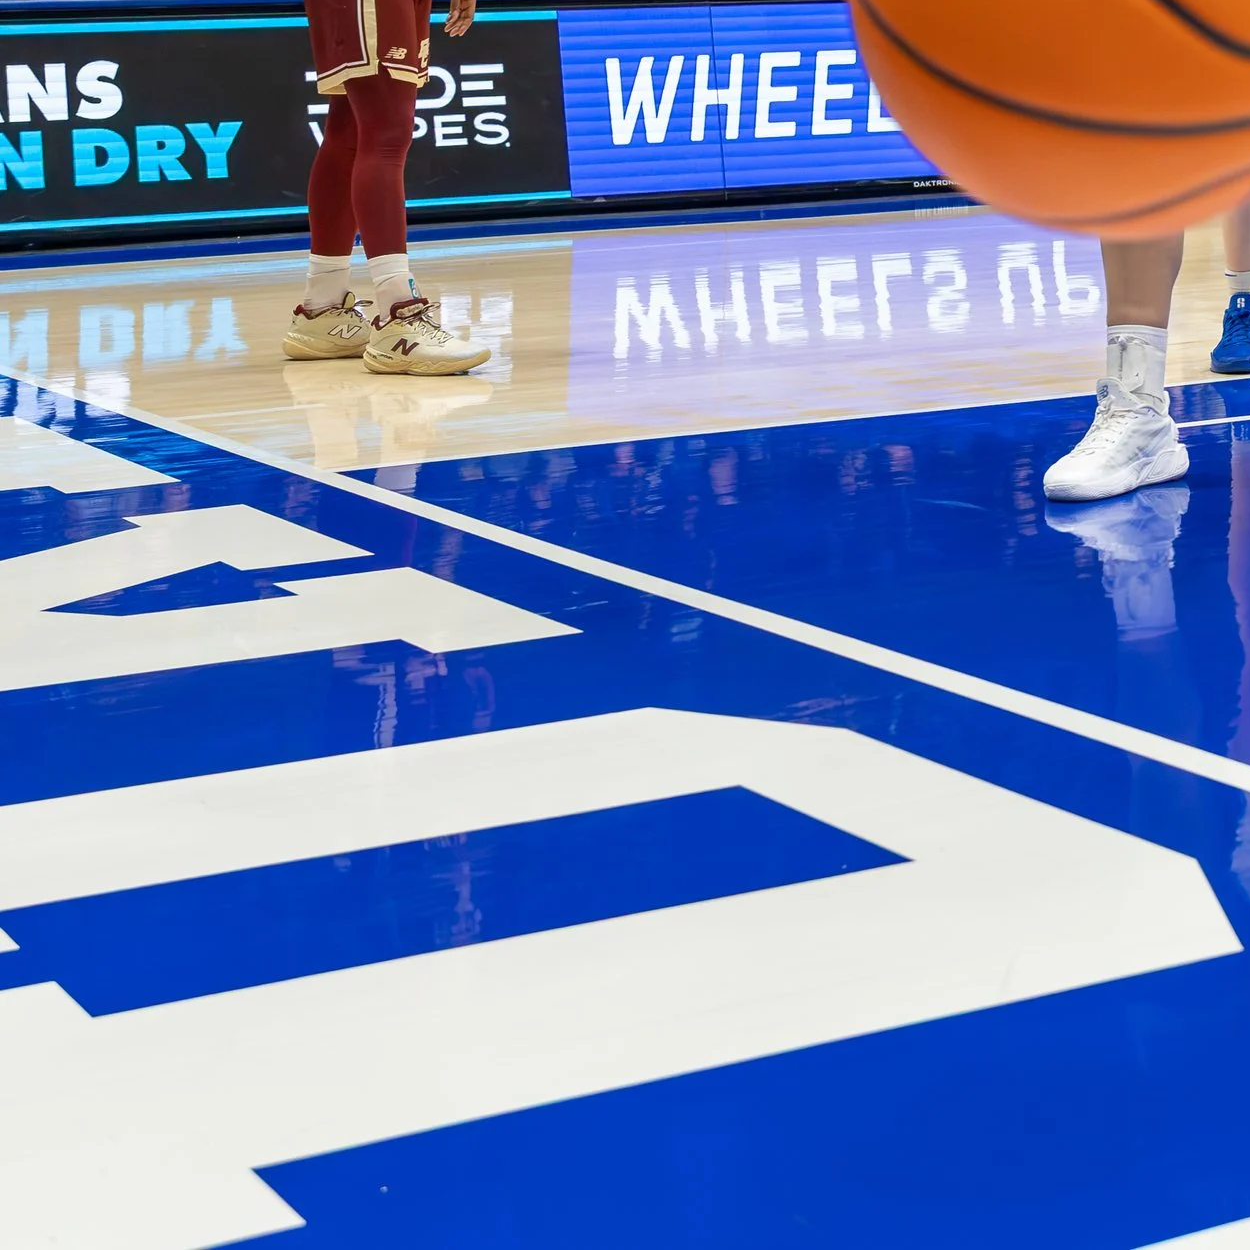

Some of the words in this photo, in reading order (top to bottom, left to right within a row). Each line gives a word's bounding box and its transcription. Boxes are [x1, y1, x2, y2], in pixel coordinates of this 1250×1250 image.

[0, 60, 124, 124] NS
[606, 49, 903, 146] WHEEL
[73, 120, 243, 187] DRY
